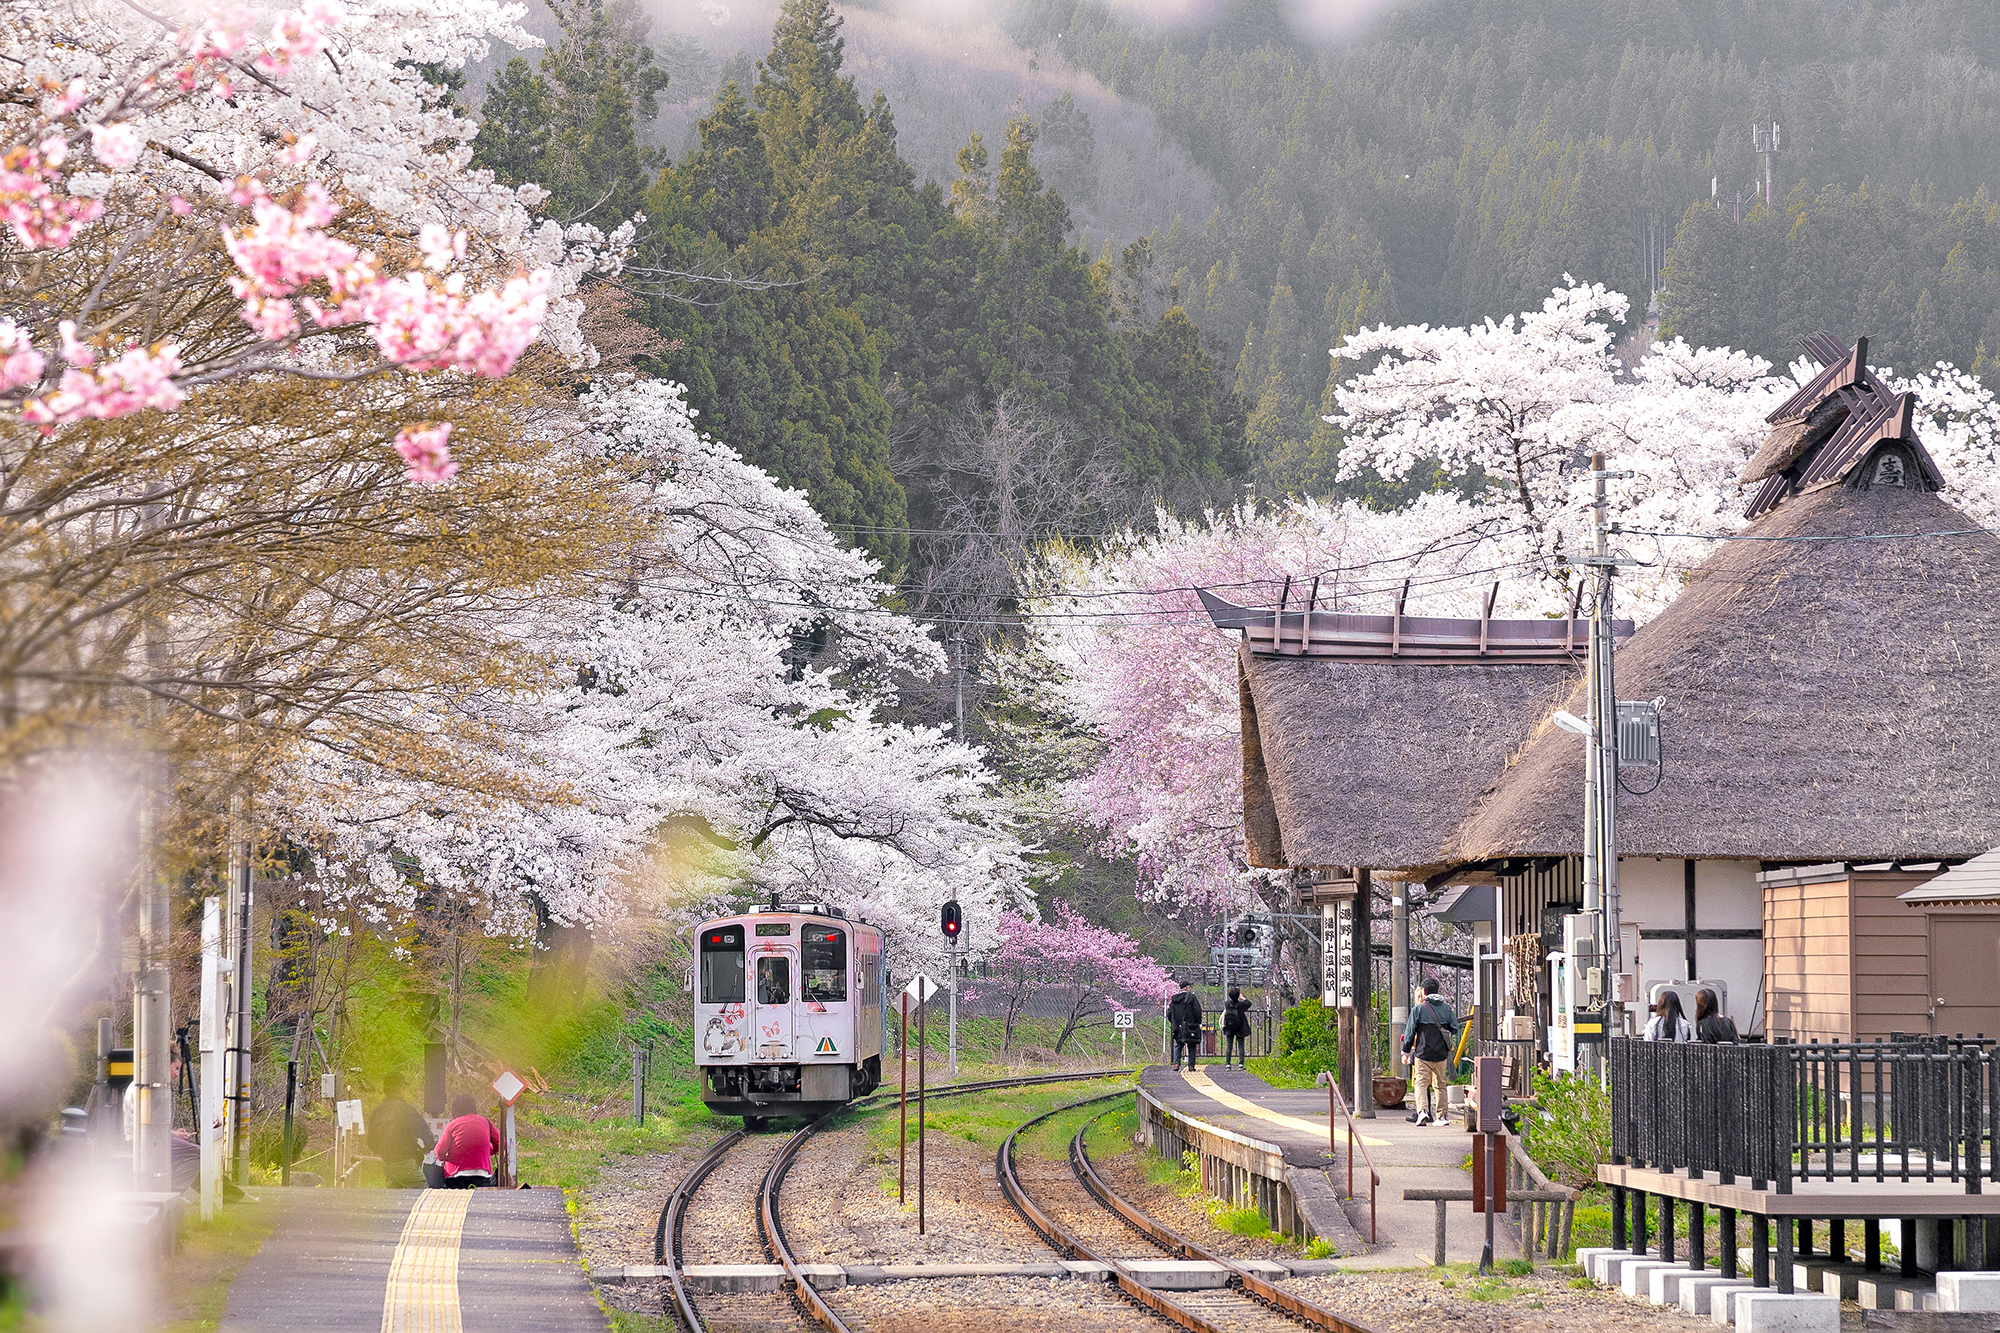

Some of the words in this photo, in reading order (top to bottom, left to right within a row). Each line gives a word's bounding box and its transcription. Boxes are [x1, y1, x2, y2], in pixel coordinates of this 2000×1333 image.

[1340, 908, 1353, 998] 湯野上温泉駅
[1116, 1013, 1132, 1026] 25
